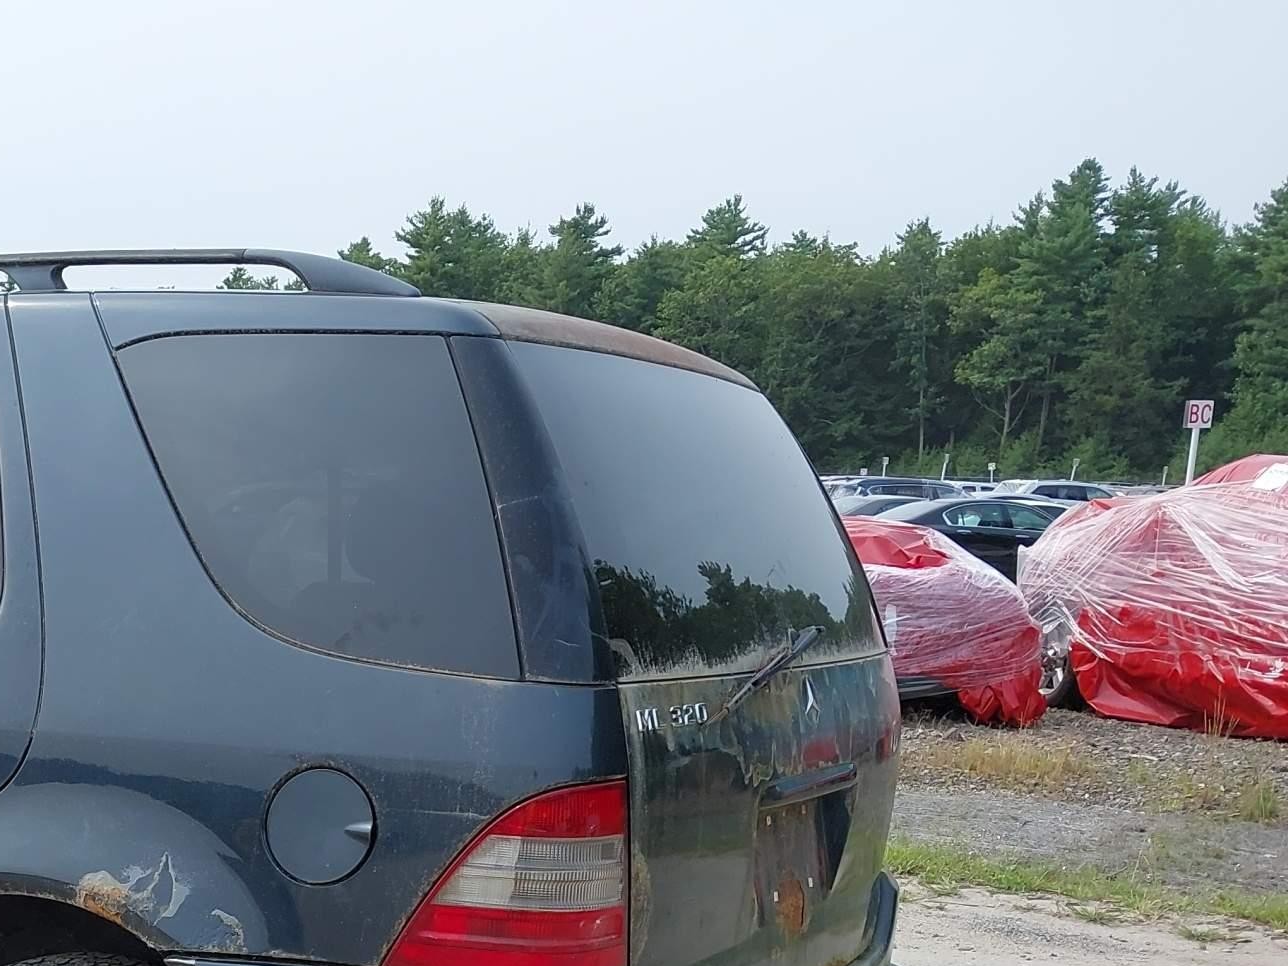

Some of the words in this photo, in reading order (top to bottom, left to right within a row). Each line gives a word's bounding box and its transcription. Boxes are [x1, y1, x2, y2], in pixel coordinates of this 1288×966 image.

[1189, 403, 1212, 424] BC
[635, 707, 667, 732] ML
[669, 702, 709, 728] 320
